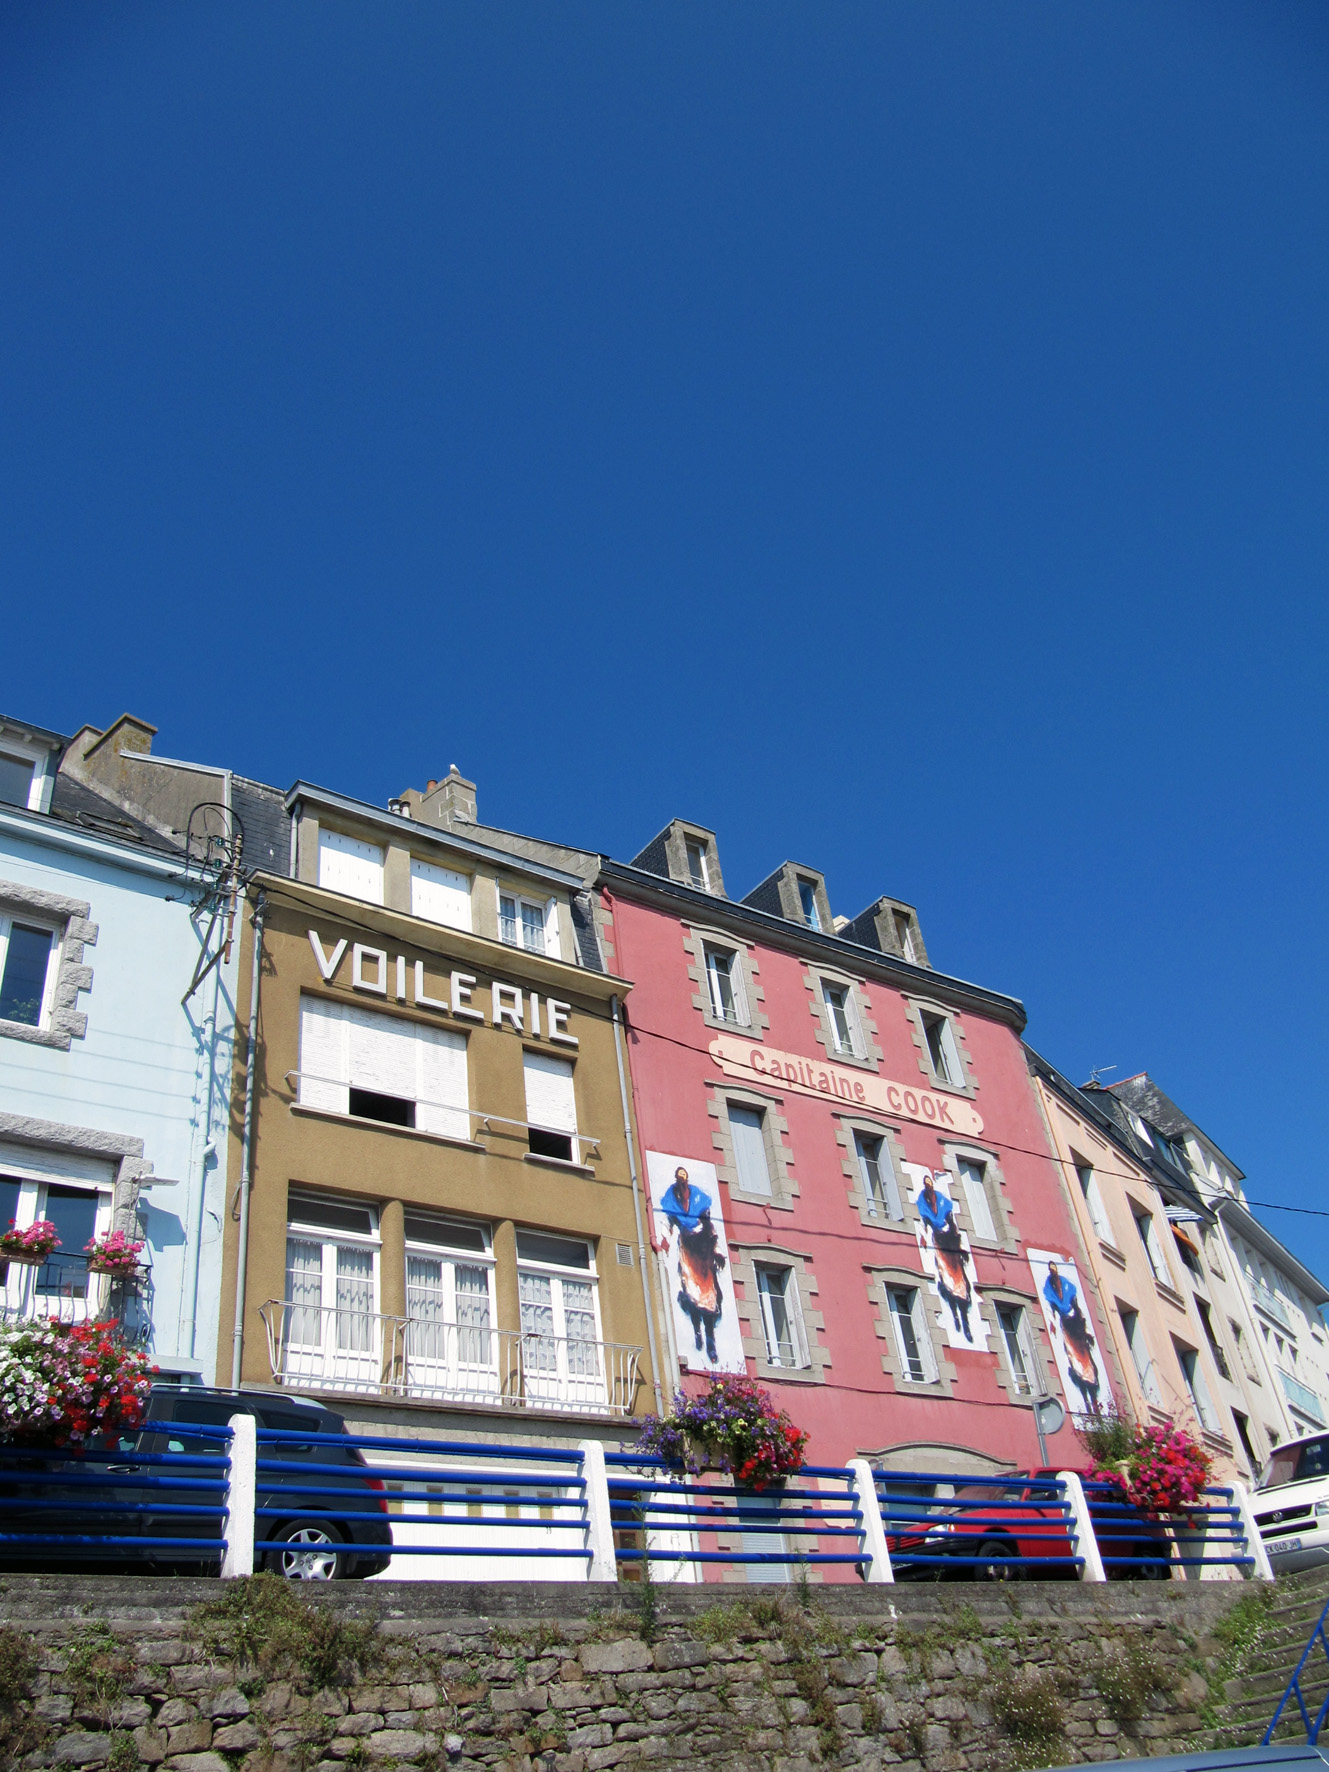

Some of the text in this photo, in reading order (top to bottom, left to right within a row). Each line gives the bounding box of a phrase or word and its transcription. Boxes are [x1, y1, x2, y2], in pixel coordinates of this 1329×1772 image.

[308, 929, 579, 1047] VOILERIE
[749, 1049, 955, 1126] Capitaine COOK
